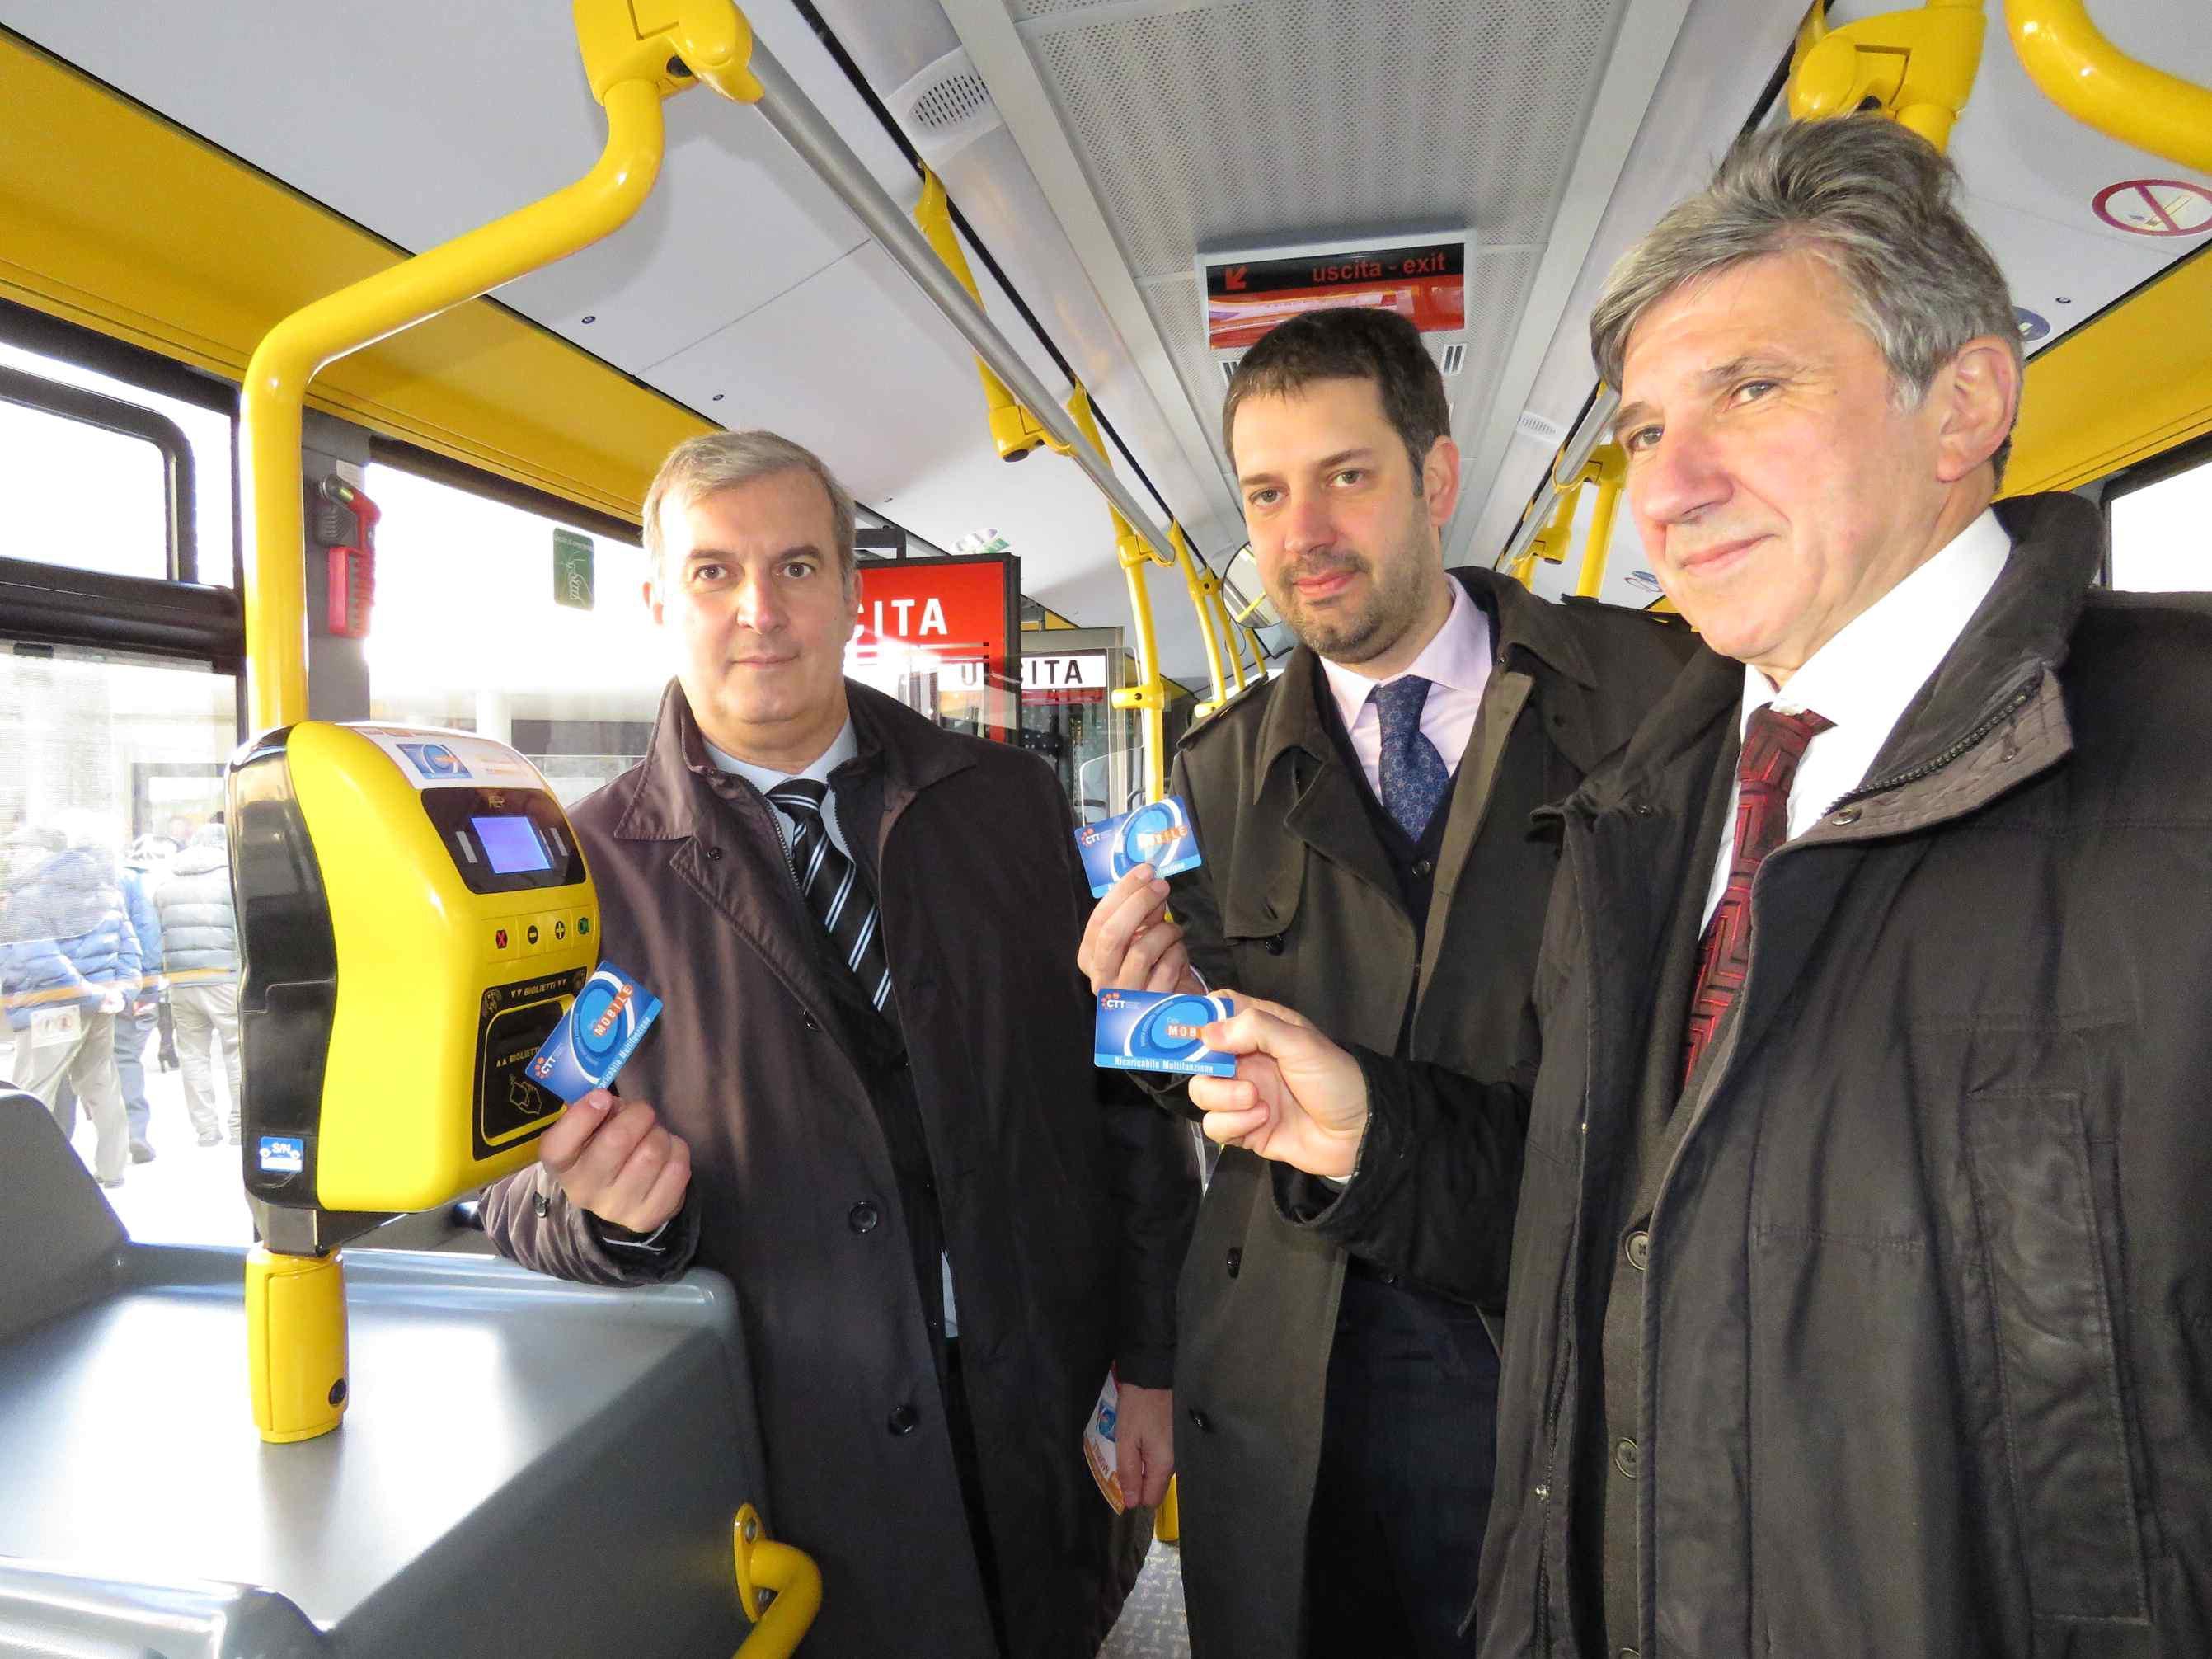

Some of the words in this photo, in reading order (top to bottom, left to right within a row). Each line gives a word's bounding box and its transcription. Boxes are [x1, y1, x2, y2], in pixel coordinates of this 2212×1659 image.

[1313, 258, 1383, 282] uscita
[1403, 252, 1447, 275] exit
[850, 598, 948, 638] CITA
[594, 985, 632, 1036] MOBILE
[1106, 999, 1126, 1009] CTT
[1167, 1025, 1197, 1037] MOB
[510, 1046, 539, 1063] BIGLIETT
